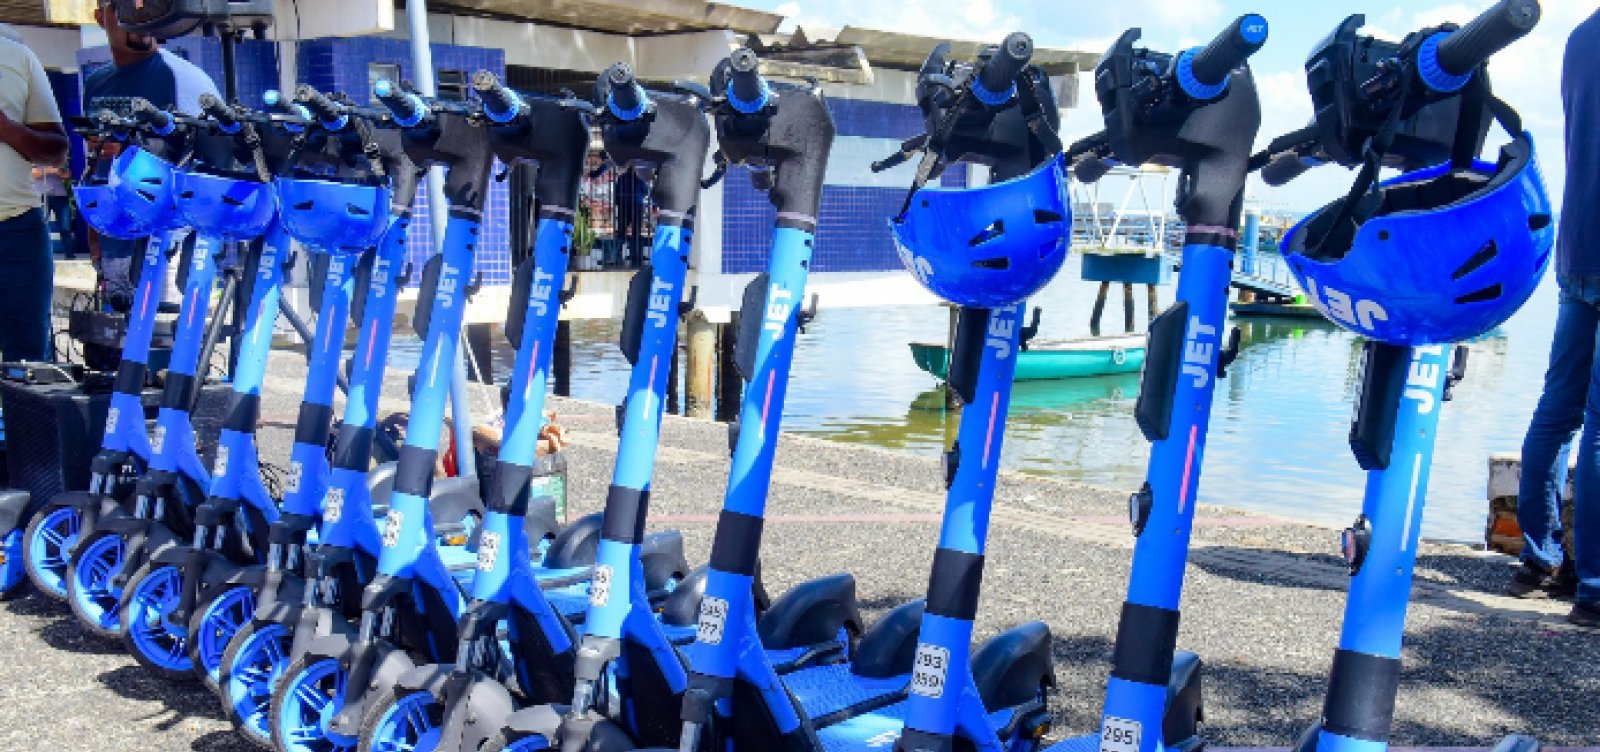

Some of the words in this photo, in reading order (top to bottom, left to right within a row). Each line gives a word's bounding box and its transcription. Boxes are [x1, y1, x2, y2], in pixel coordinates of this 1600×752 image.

[257, 242, 278, 280] JET
[370, 256, 391, 298] JET
[435, 262, 460, 308] JET
[528, 266, 556, 317] JET
[647, 276, 675, 328] JET
[763, 282, 794, 340] JET
[1182, 316, 1218, 389] JET
[1103, 725, 1133, 745] 295
